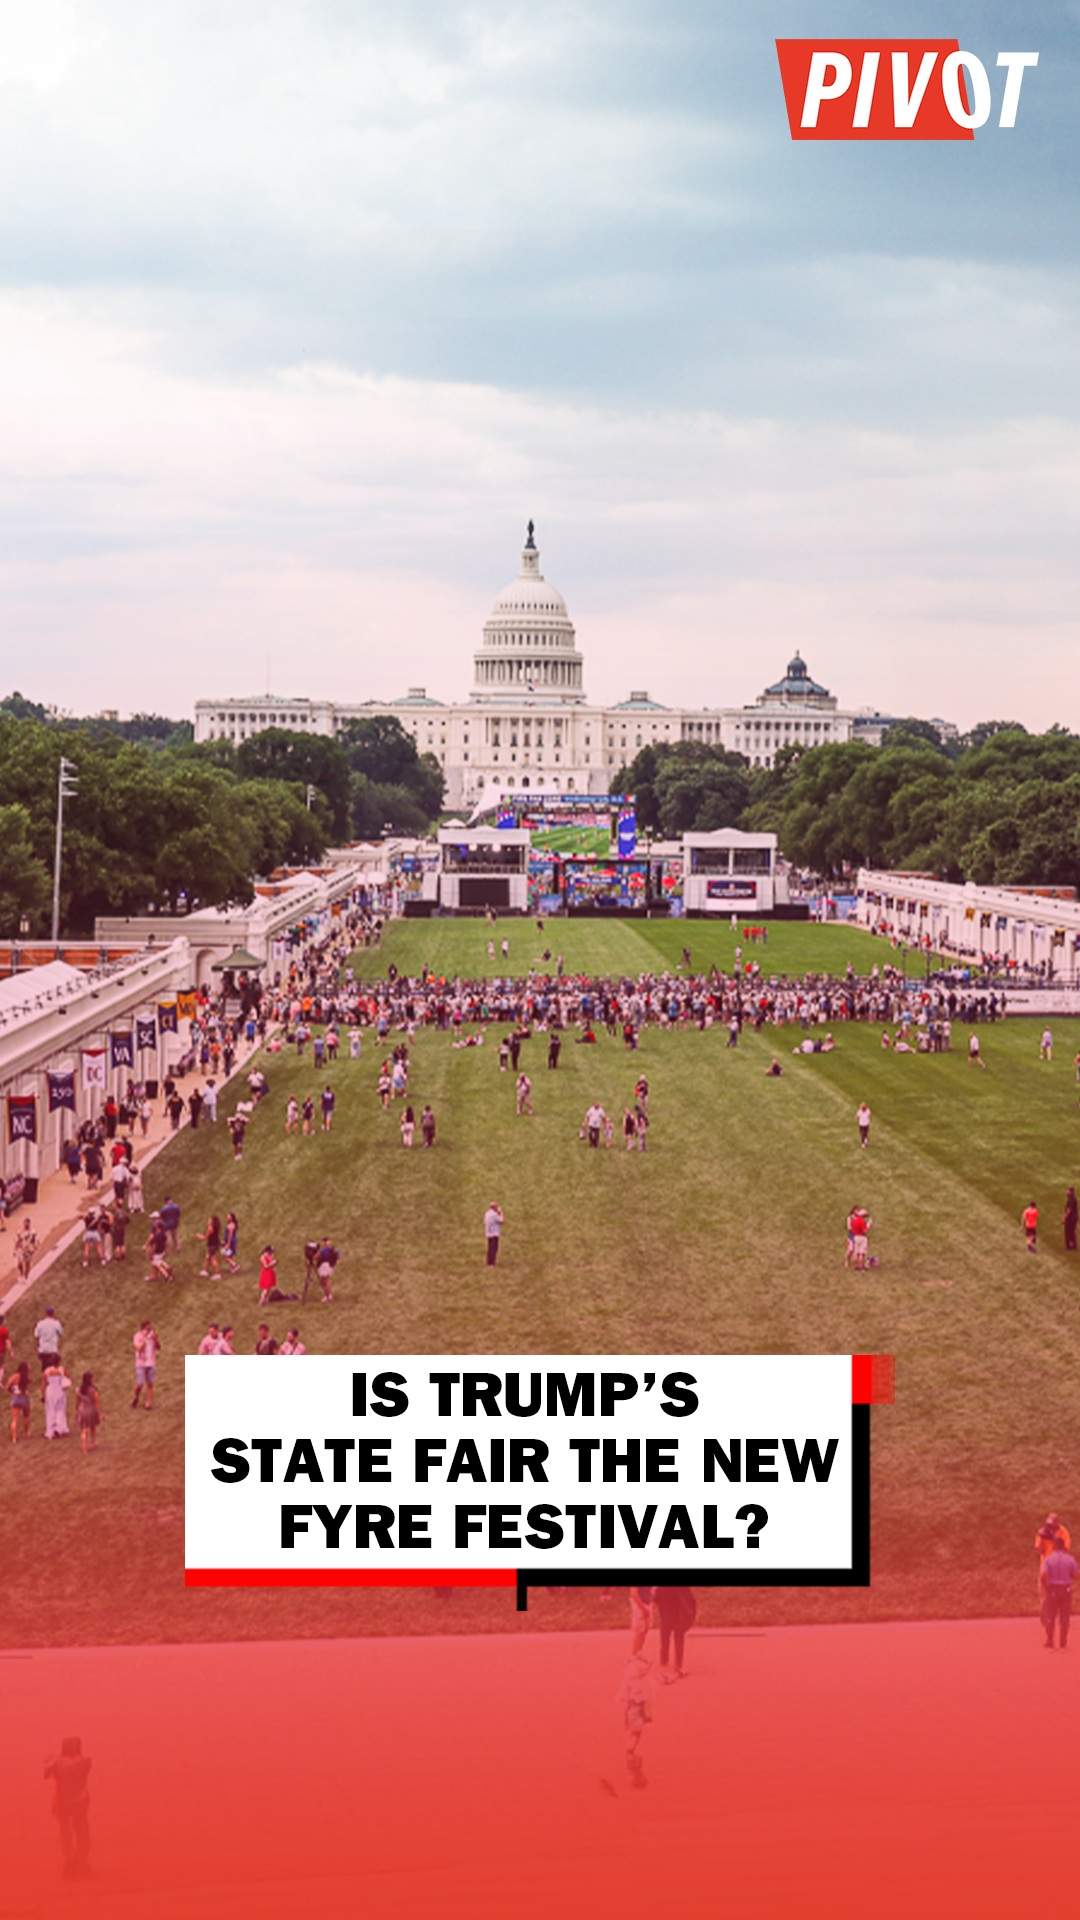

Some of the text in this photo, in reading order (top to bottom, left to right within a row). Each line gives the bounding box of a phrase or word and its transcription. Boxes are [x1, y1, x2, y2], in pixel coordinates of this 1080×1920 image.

[140, 1030, 153, 1045] SC
[114, 1047, 130, 1062] VA
[86, 1066, 103, 1082] DC
[12, 1114, 33, 1134] NC
